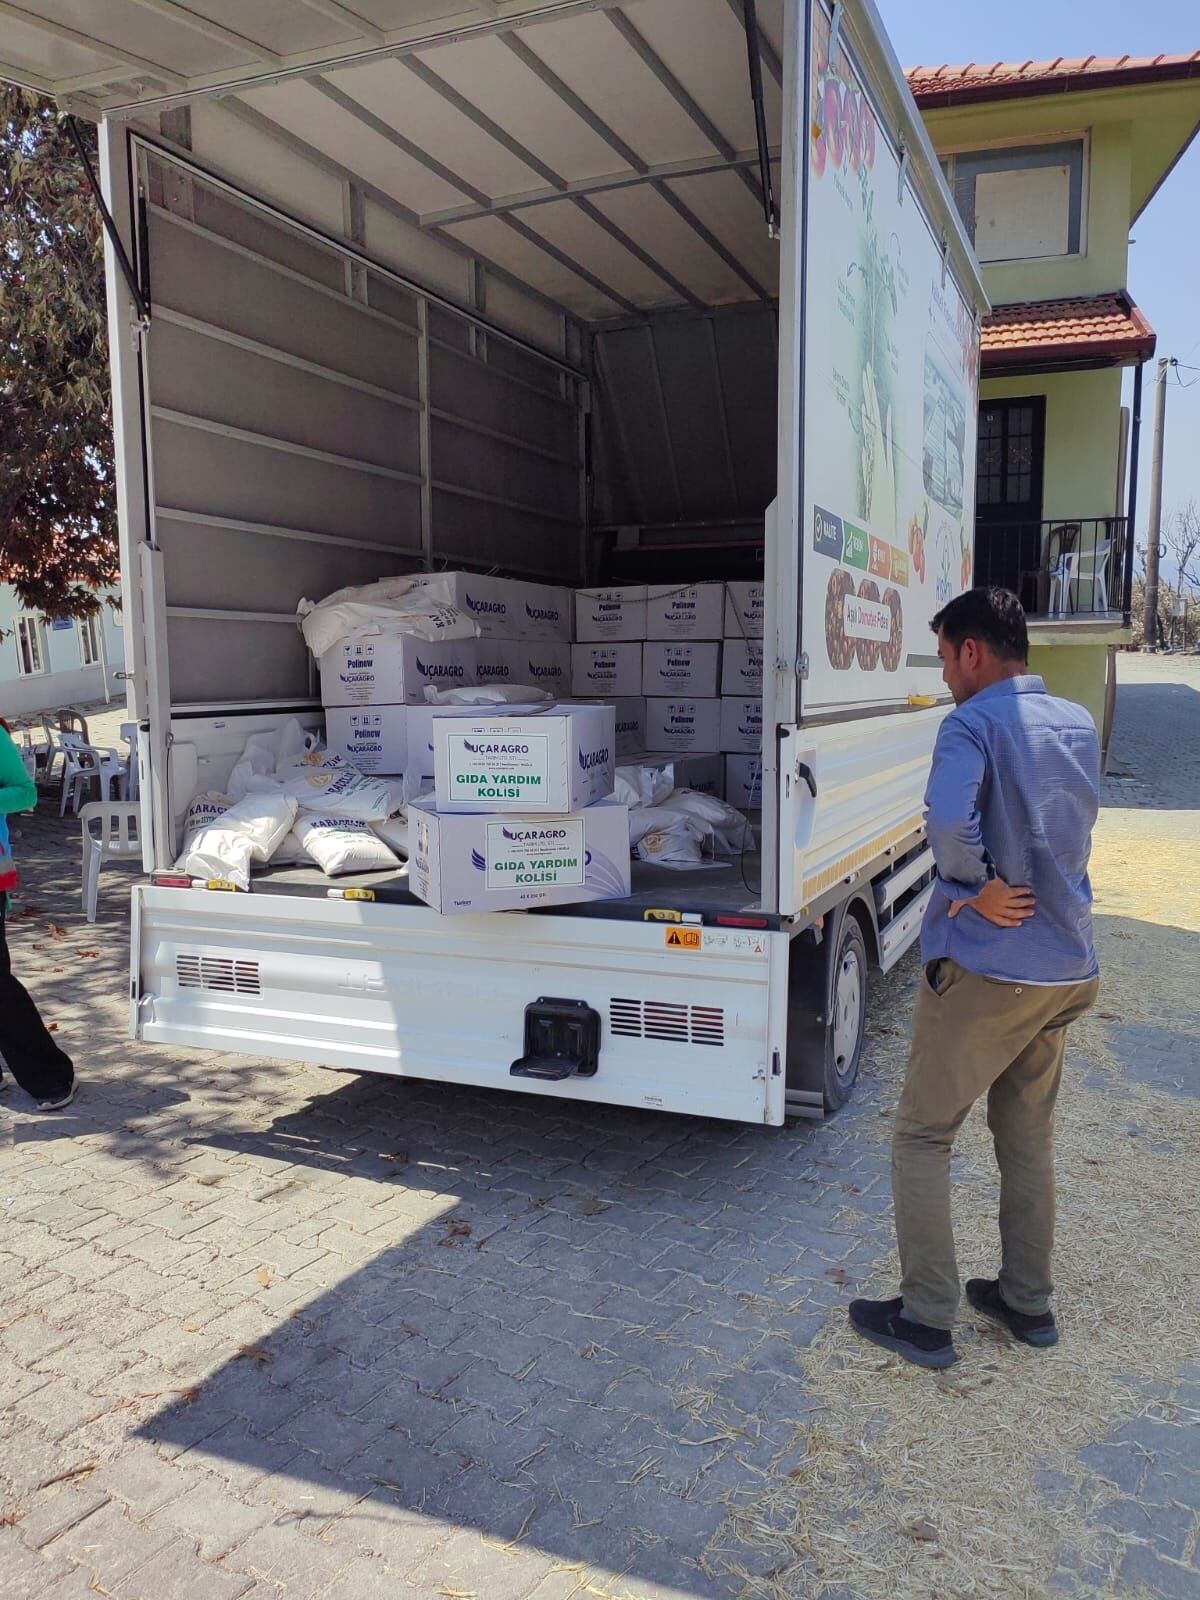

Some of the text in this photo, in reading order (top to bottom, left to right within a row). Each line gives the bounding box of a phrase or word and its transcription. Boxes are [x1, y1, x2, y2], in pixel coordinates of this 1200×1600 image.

[472, 600, 506, 614] UÇARAGRO
[672, 601, 695, 609] Polinow
[530, 608, 559, 621] UÇARAGRO
[858, 606, 877, 627] Domates
[347, 659, 373, 669] Polinow
[667, 659, 690, 667] Polinow
[422, 665, 464, 680] UÇARAGRO
[533, 665, 562, 677] UÇARAGRO
[344, 675, 375, 683] UÇARAGRO
[671, 715, 694, 724] Polinow
[354, 729, 381, 739] Polinow
[351, 744, 383, 753] UÇARAGRO
[472, 744, 529, 756] UÇARAGRO
[583, 747, 608, 774] UÇARAGRO
[456, 774, 541, 785] GIDA YARDIM
[477, 786, 520, 798] KOLİSİ
[511, 829, 566, 842] UÇARAGRO
[494, 861, 526, 871] GIDA
[529, 858, 577, 870] YARDIM
[515, 870, 557, 883] KOLİSİ
